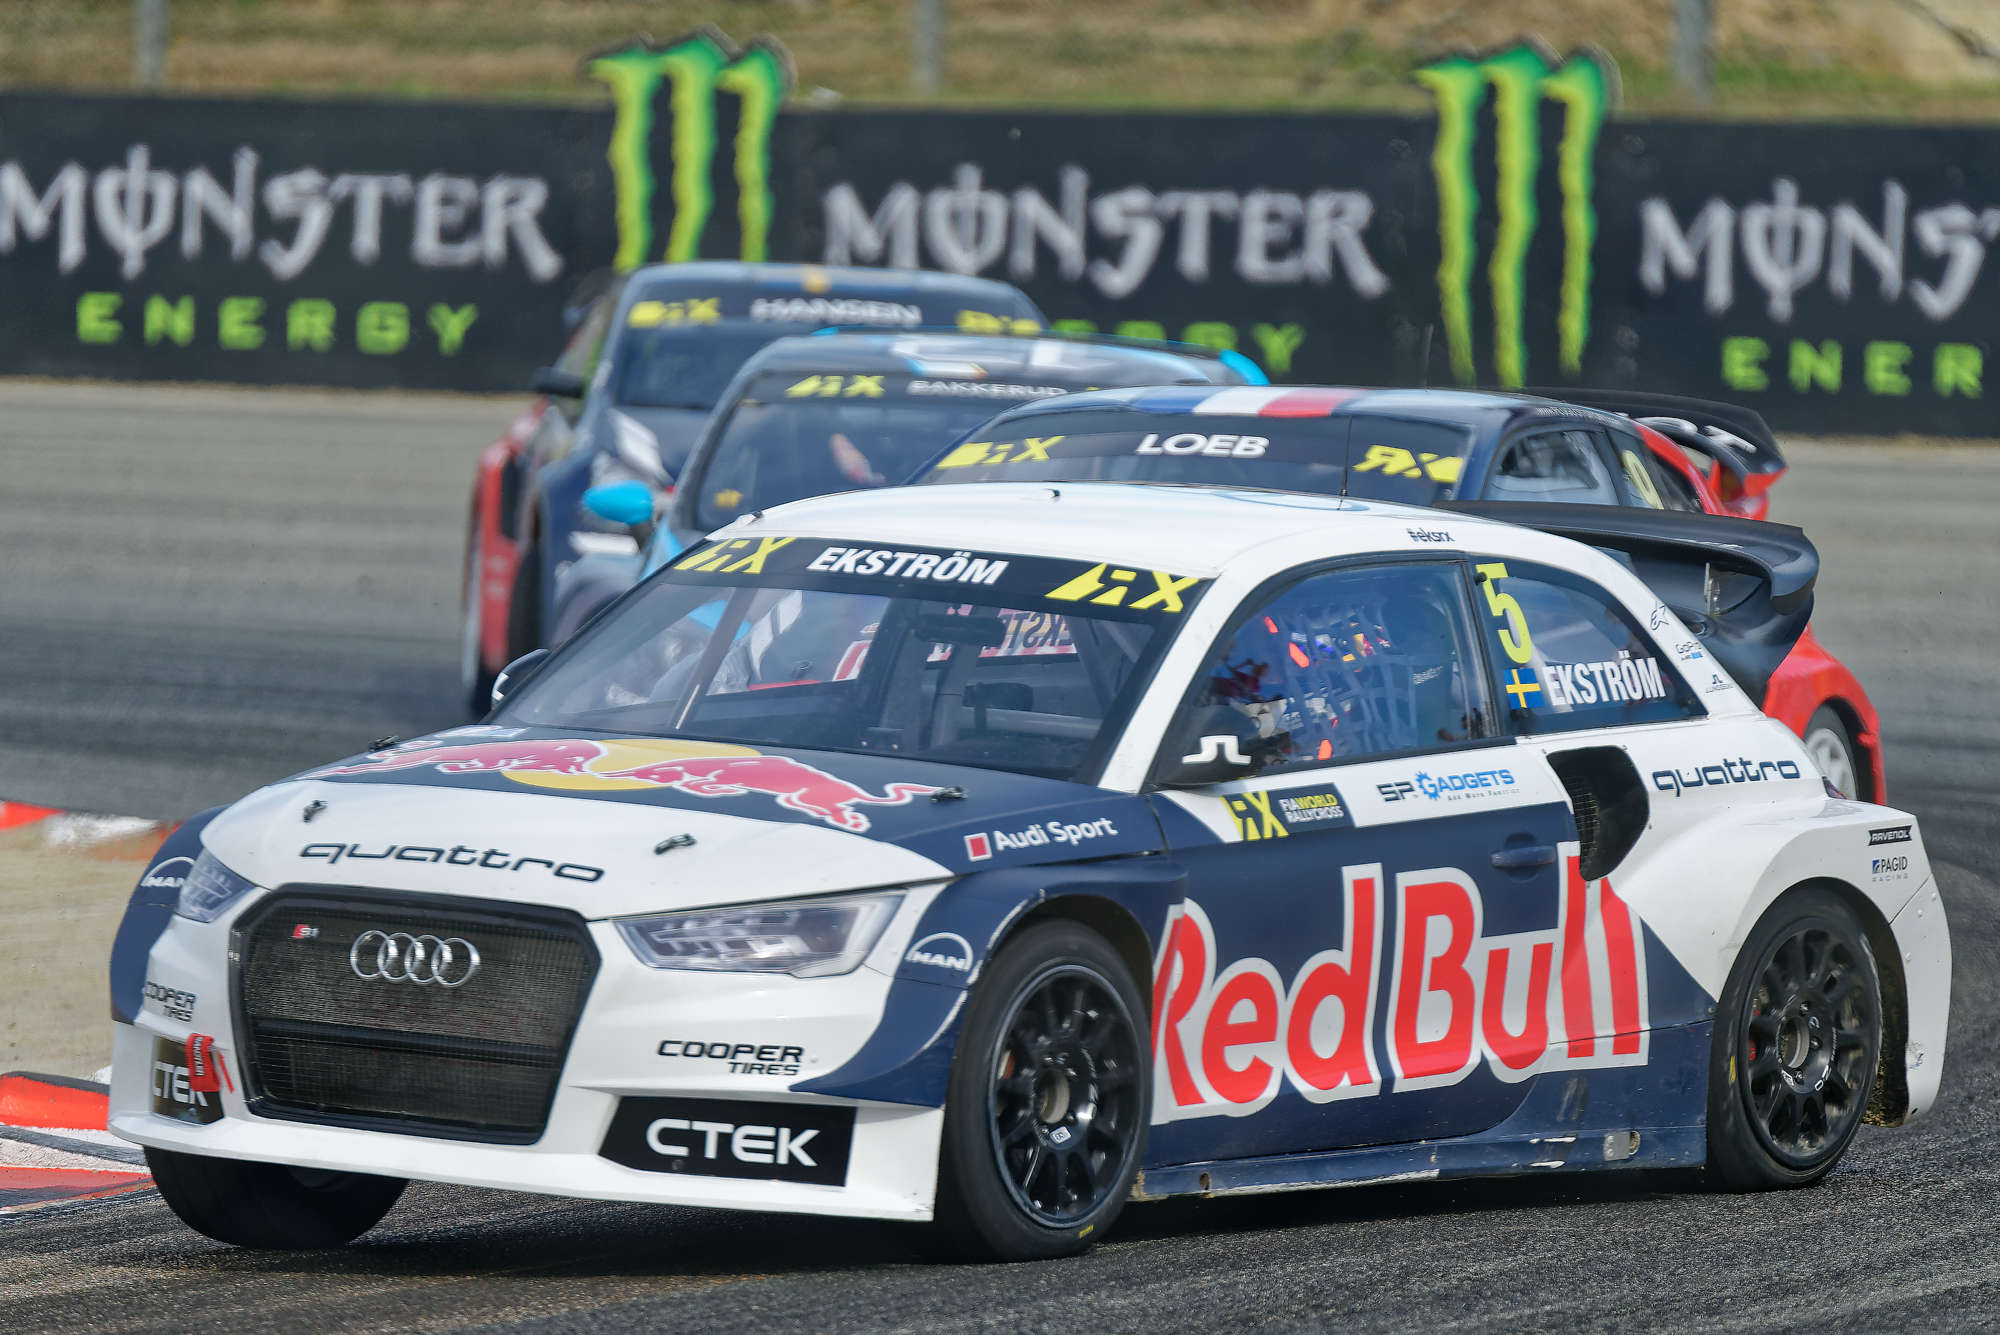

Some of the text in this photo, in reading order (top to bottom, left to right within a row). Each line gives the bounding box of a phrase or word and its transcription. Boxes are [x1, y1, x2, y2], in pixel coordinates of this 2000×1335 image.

[76, 292, 478, 355] ENERGY
[1134, 432, 1270, 459] LOEB
[806, 545, 1010, 586] EKSTRÖM
[1475, 562, 1532, 664] 5
[1543, 650, 1666, 707] EKSTRÖM
[1415, 769, 1515, 800] GADGETS
[1652, 757, 1801, 797] quattro
[993, 817, 1118, 851] Audi Sport
[299, 842, 604, 883] quattro
[1881, 856, 1908, 873] PAGID
[911, 951, 967, 971] MAN
[1152, 842, 1649, 1118] Red Bull
[657, 1040, 804, 1063] COOPER
[728, 1061, 802, 1076] TIRES
[645, 1117, 820, 1168] CTEK
